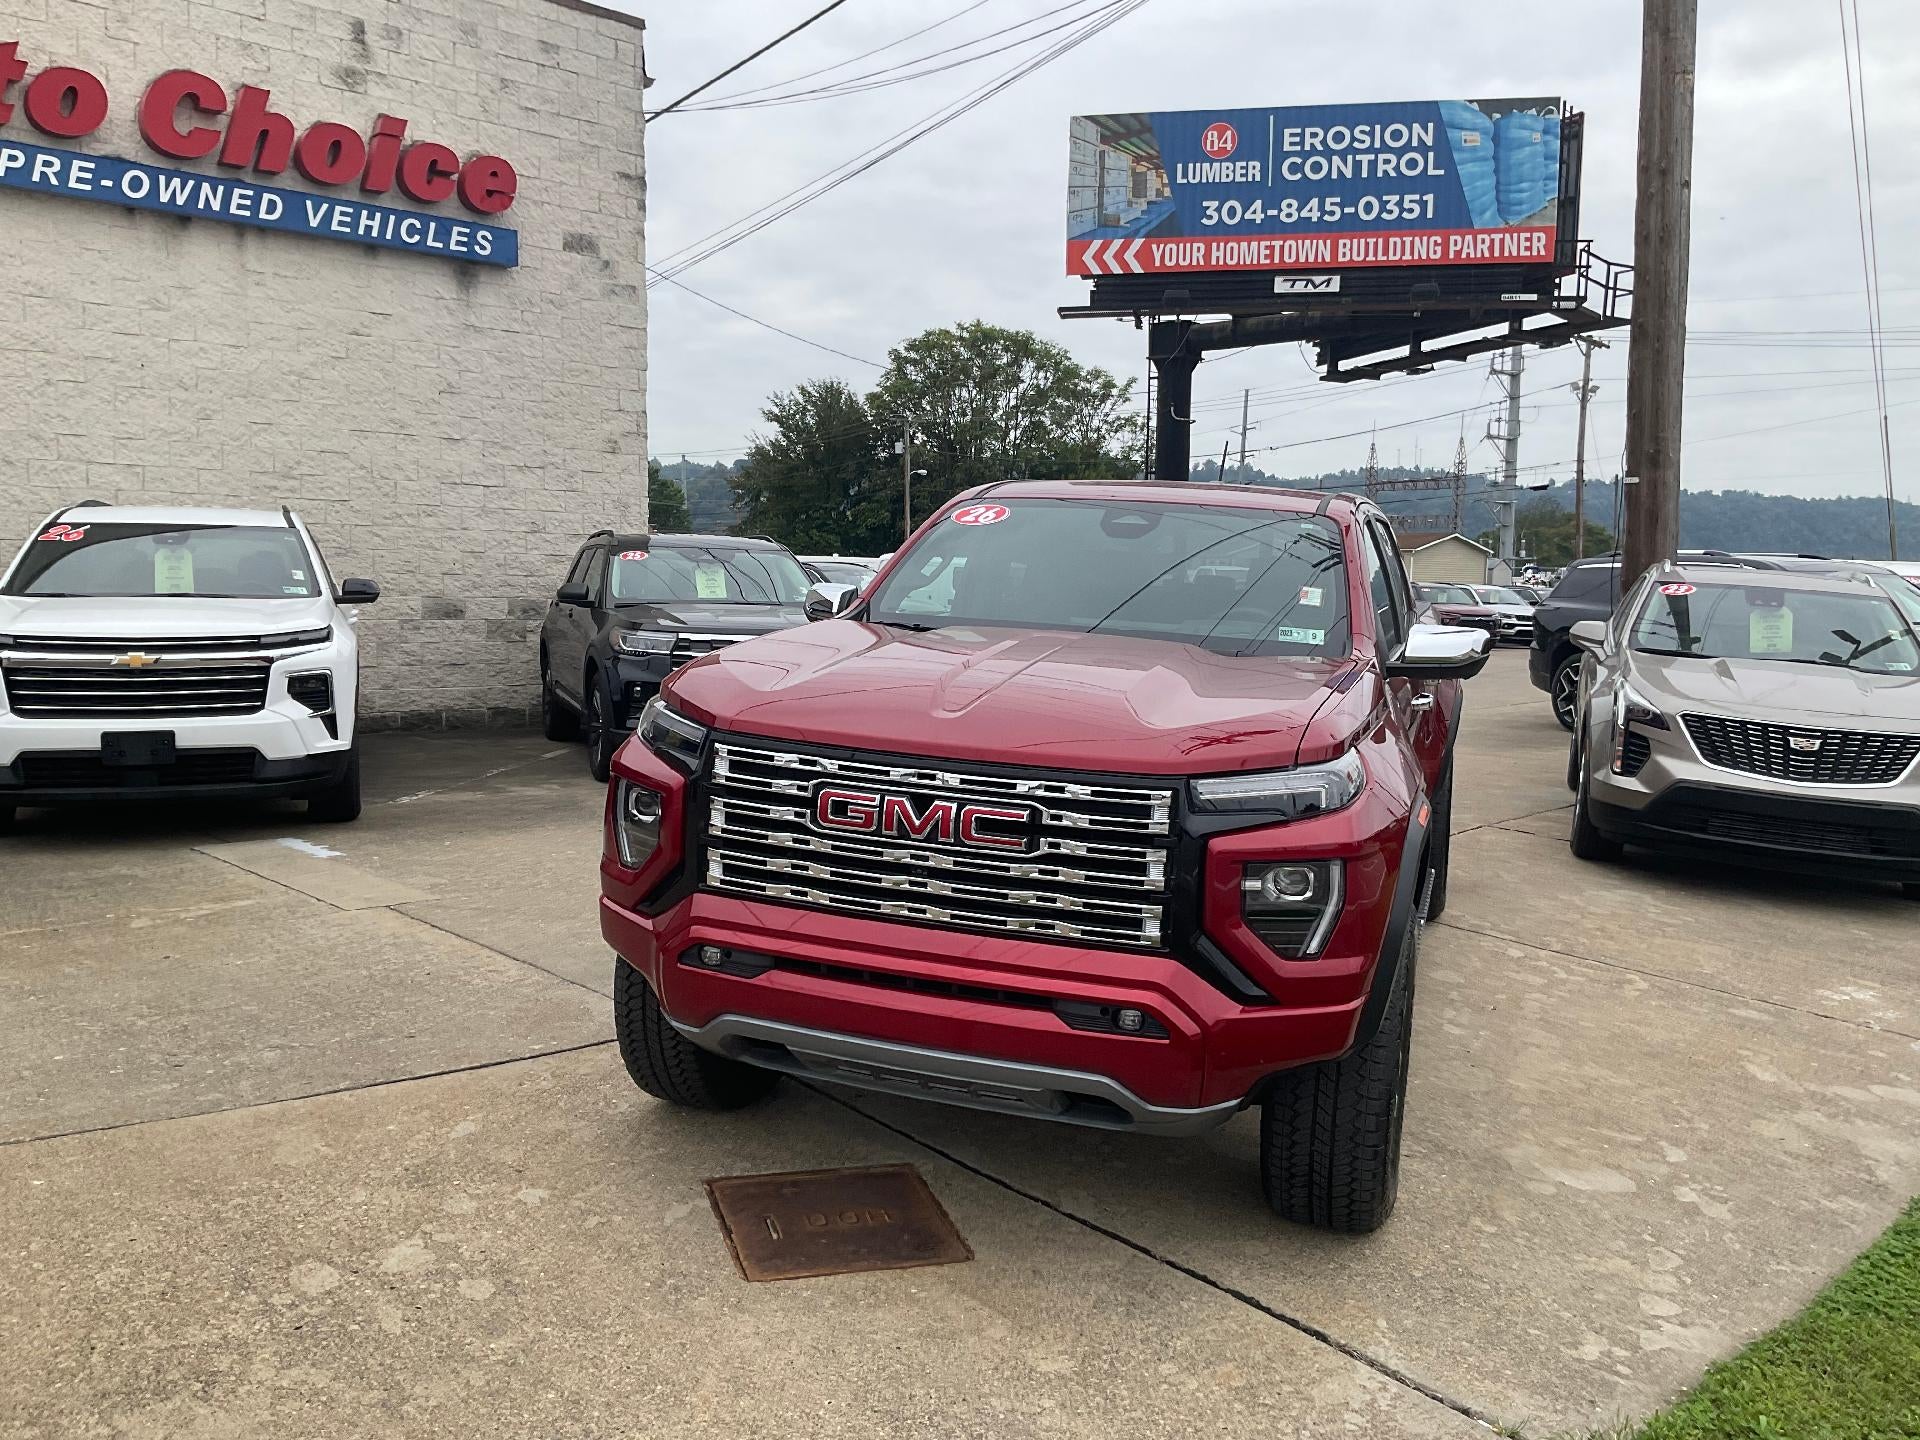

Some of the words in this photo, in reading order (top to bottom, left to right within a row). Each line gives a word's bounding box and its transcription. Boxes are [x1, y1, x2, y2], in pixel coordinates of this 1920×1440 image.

[138, 68, 517, 214] Choice
[1206, 129, 1234, 153] 84
[1282, 122, 1434, 153] EROSION
[1176, 161, 1261, 184] LUMBER
[1281, 151, 1444, 182] CONTROL
[0, 148, 283, 222] PRE-OWNED
[305, 199, 493, 256] VEHICLES
[1200, 193, 1435, 226] 304-845-0351
[1152, 241, 1206, 267] YOUR
[1211, 239, 1331, 265] HOMETOWN
[1338, 235, 1443, 262] BUILDING
[1448, 231, 1547, 259] PARTNER
[1280, 277, 1334, 290] TM
[960, 506, 1001, 525] 26
[38, 525, 91, 542] 26
[817, 787, 1031, 852] GMC
